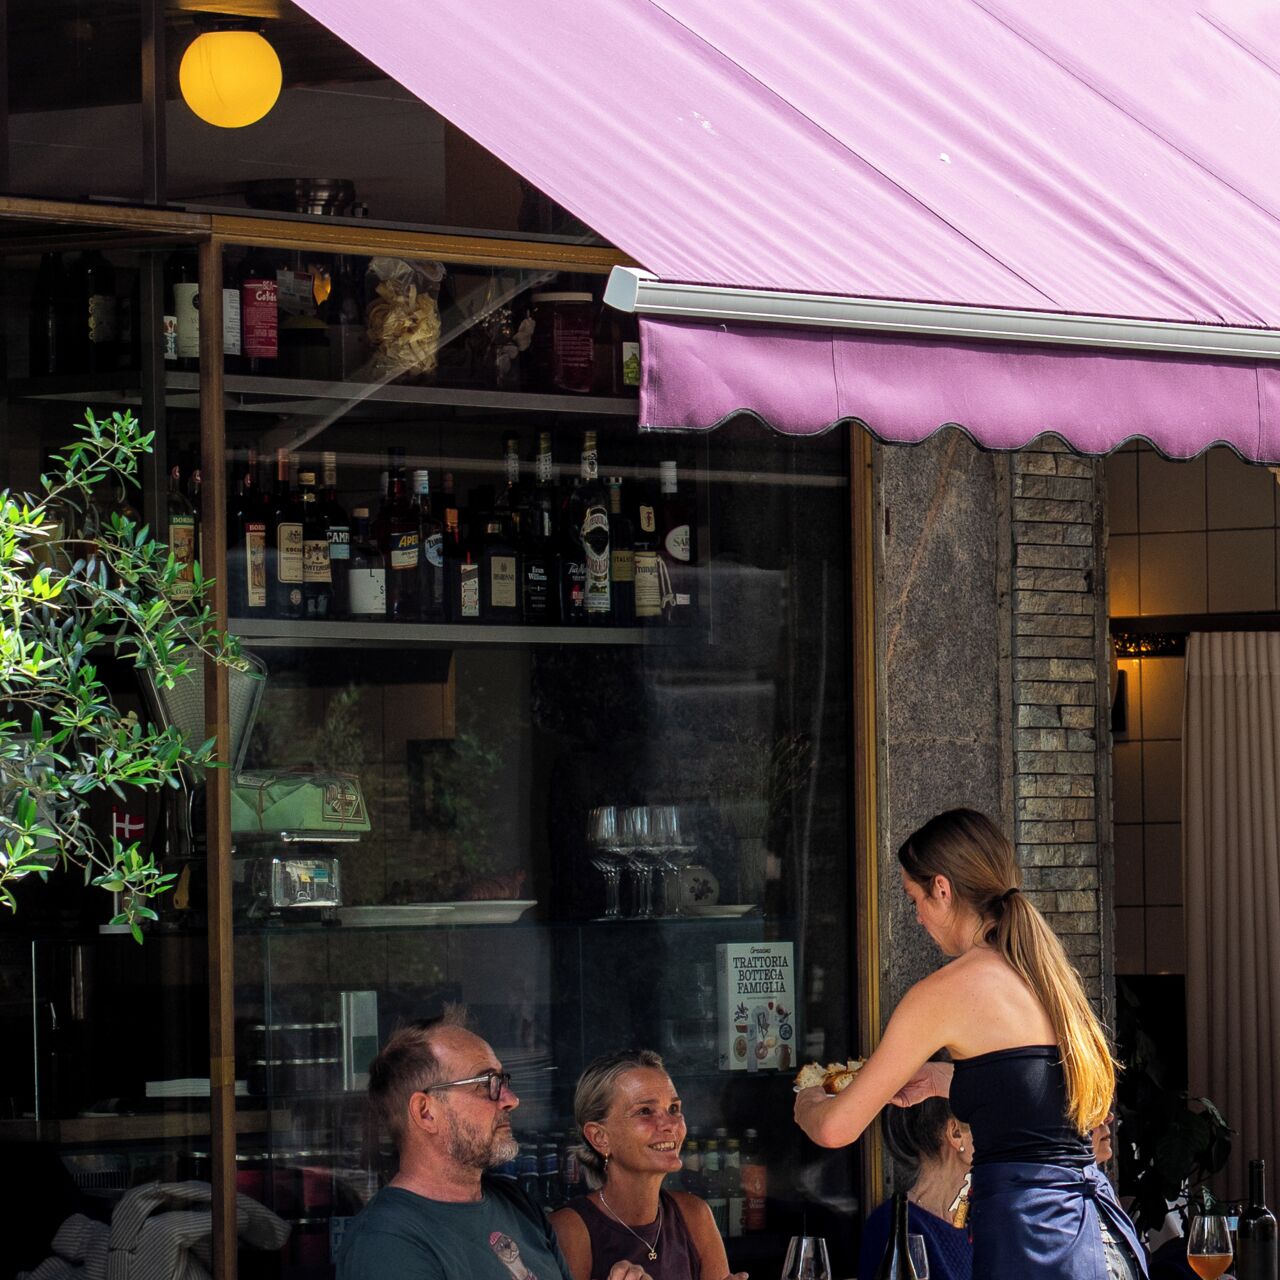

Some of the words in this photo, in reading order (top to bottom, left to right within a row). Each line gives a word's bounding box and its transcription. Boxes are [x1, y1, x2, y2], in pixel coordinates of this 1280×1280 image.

[732, 956, 790, 969] TRATTORIA
[737, 968, 785, 982] BOTTEGA
[736, 981, 787, 995] FAMIGLIA
